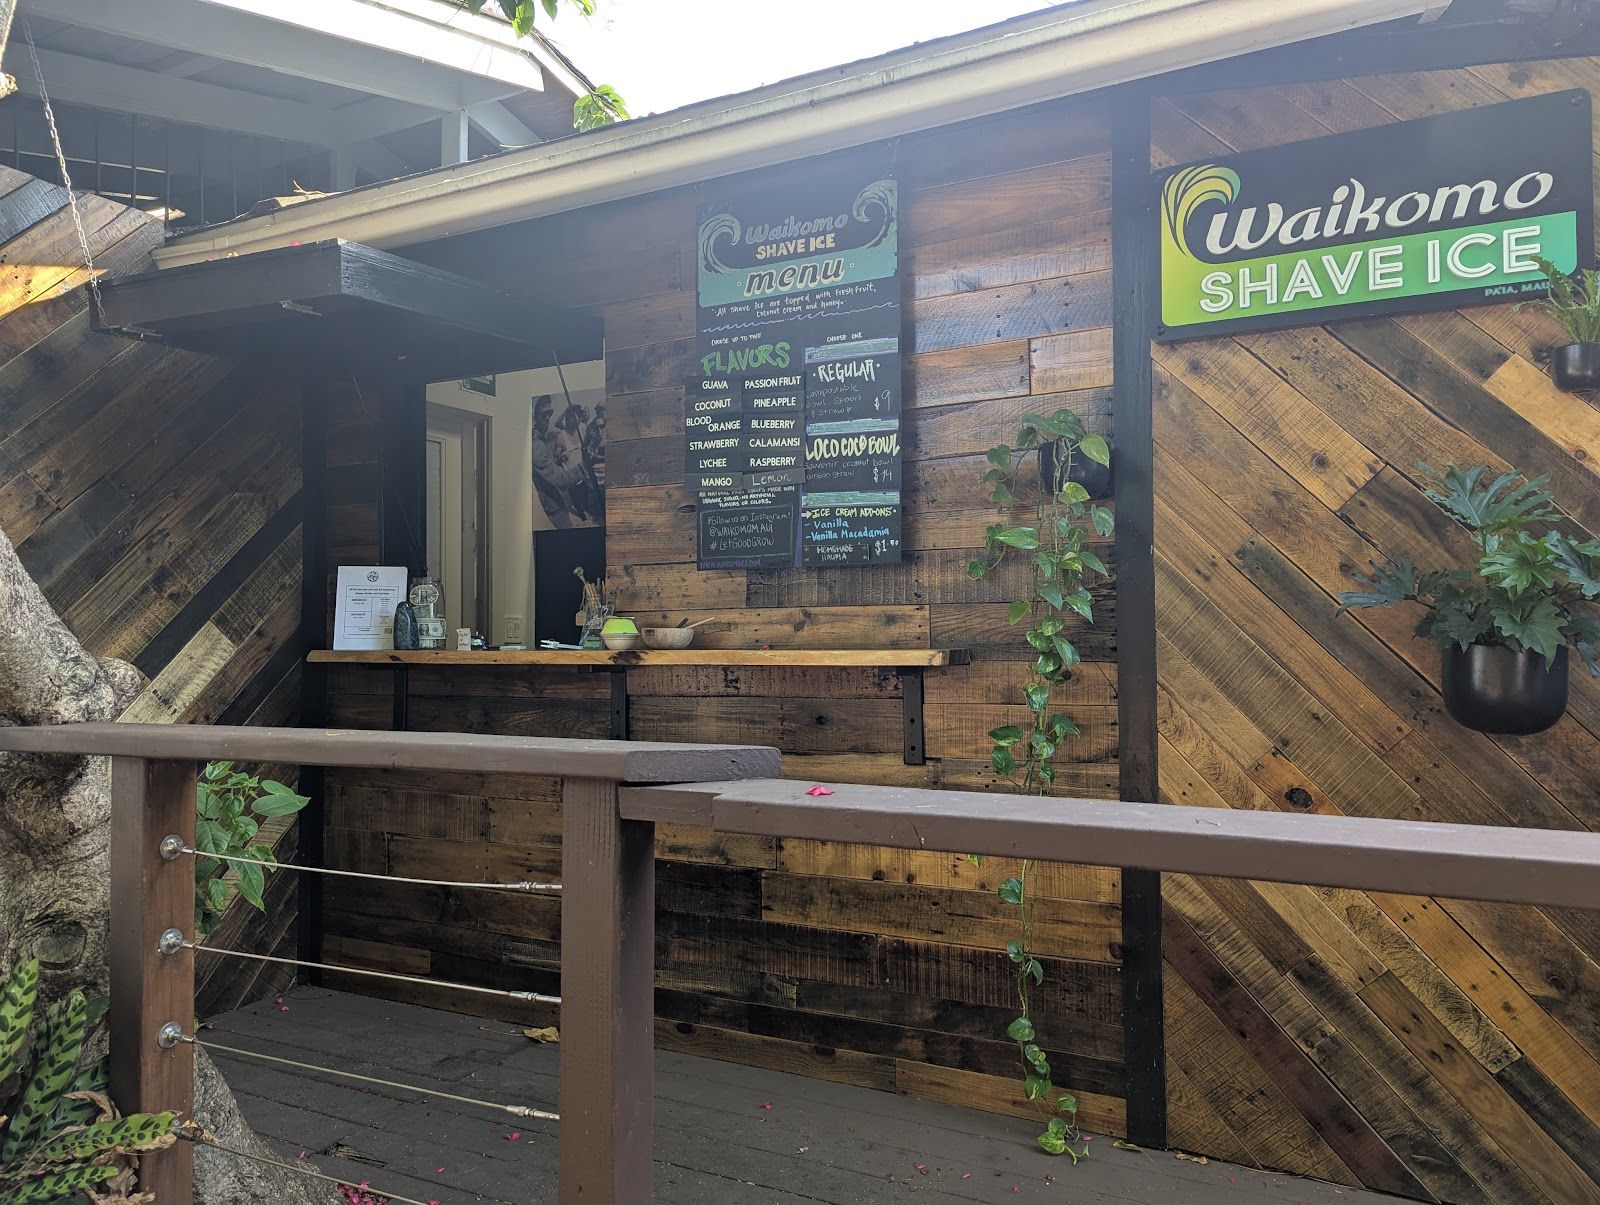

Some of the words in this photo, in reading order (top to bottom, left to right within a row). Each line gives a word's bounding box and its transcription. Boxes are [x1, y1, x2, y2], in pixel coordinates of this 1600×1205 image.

[1205, 171, 1554, 256] Waikomo
[745, 213, 849, 244] Waikomo
[756, 239, 806, 260] SHAVE
[809, 232, 836, 252] ICE
[1199, 244, 1404, 313] SHAVE
[1427, 224, 1542, 284] ICE
[743, 257, 846, 297] menu
[1521, 281, 1552, 292] MAU
[730, 305, 750, 313] shave
[784, 294, 810, 306] topped
[815, 290, 831, 300] with
[756, 307, 780, 318] coconut
[782, 305, 802, 314] cream
[805, 302, 818, 310] and
[826, 334, 847, 343] CHOOSE
[851, 331, 863, 340] ONE
[701, 341, 791, 376] FLAVORS
[817, 359, 876, 383] REGULAR
[702, 380, 729, 390] GUAVA
[744, 378, 778, 390] PASSION
[778, 375, 802, 387] FRUIT
[694, 398, 732, 411] COCONUT
[753, 397, 797, 408] PINEAPPLE
[686, 416, 711, 427] BLOOD
[708, 420, 742, 432] ORANGE
[751, 420, 796, 429] BLUEBERRY
[689, 438, 740, 451] STRAWBERRY
[749, 437, 801, 448] CALAMANSI
[805, 437, 840, 461] LOCO
[840, 434, 867, 457] COCO
[867, 433, 901, 457] BOWL
[699, 458, 728, 468] LYCHEE
[749, 456, 797, 467] RASPBERRY
[872, 457, 894, 467] bowl
[752, 473, 793, 486] Lemon
[806, 472, 831, 480] amboo
[872, 466, 893, 483] $14
[701, 477, 733, 487] MANGO
[811, 508, 831, 519] ICE
[835, 507, 858, 518] CREAM
[860, 506, 893, 518] ADD-ONS
[707, 515, 731, 526] Follow
[813, 517, 850, 529] Vanilla
[811, 530, 838, 542] Vanilla
[841, 526, 890, 539] Macadamia
[816, 543, 854, 554] HOMEMADE
